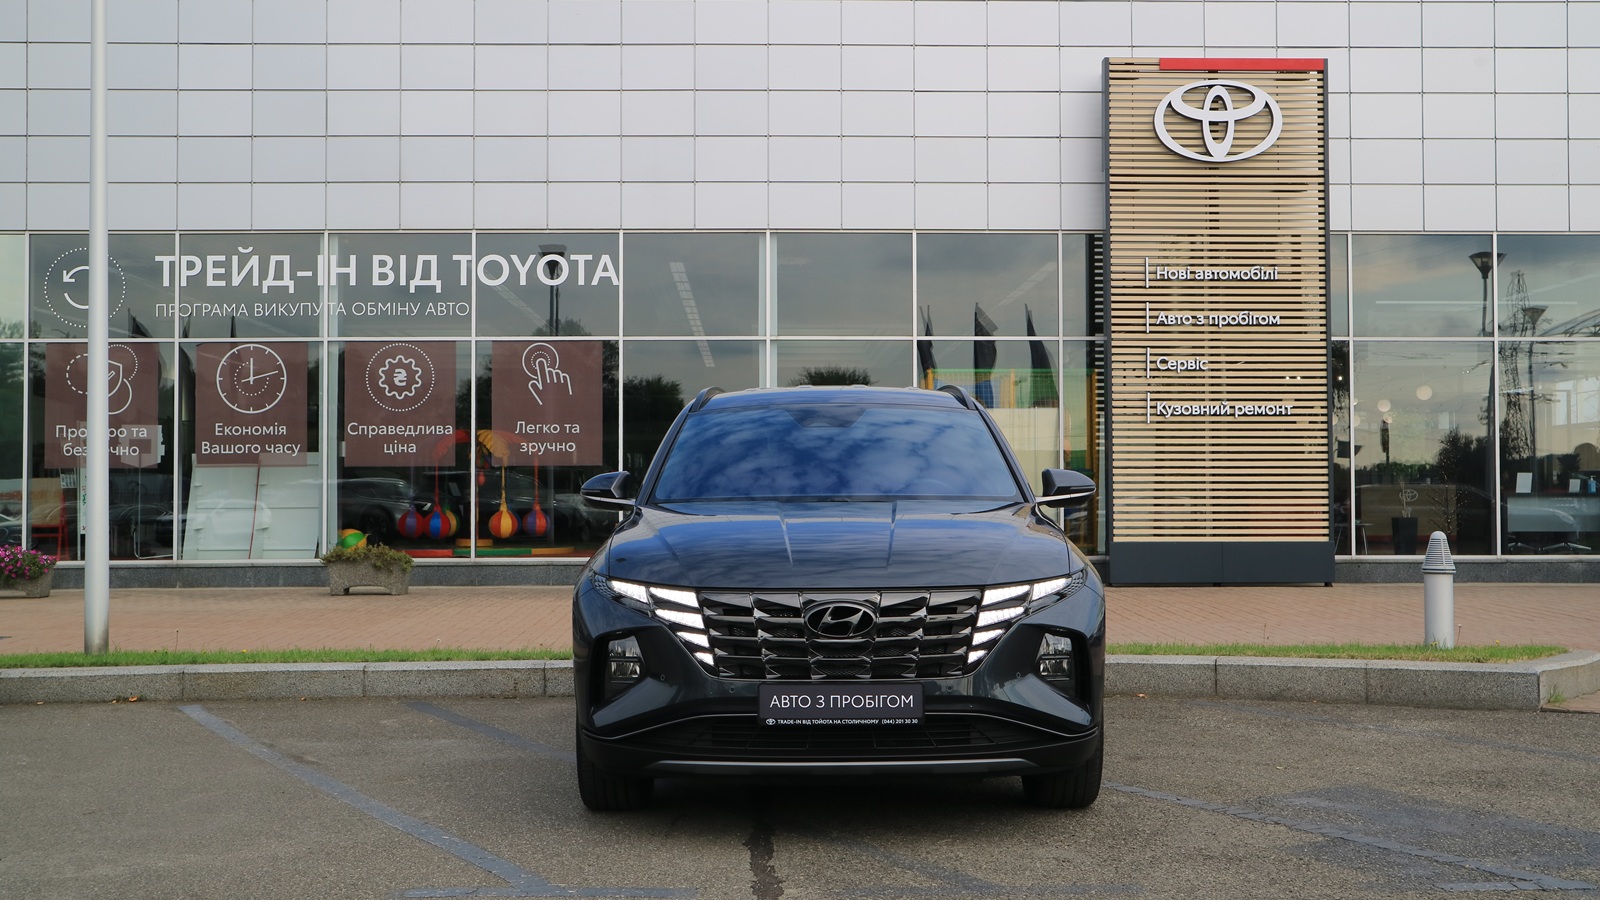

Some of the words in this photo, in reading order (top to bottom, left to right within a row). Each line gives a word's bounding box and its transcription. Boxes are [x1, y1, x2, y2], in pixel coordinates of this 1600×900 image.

[155, 246, 357, 293] ТРЕЙД-ІН
[372, 254, 442, 293] ВІД
[452, 254, 619, 286] TOYOTA
[1156, 266, 1191, 280] Нові
[1195, 266, 1278, 280] автомобілі
[155, 303, 249, 317] ПРОГРАМА
[254, 303, 323, 317] ВИКУПУ
[327, 302, 347, 316] ТА
[352, 302, 421, 316] ОБМІНУ
[425, 302, 470, 316] АВТО
[1156, 311, 1192, 325] Авто
[1196, 314, 1205, 325] з
[1209, 311, 1280, 328] пробігом
[1156, 357, 1209, 373] Сервіс
[1156, 401, 1230, 418] Кузовний
[1234, 404, 1294, 419] ремонт
[55, 425, 127, 440] Проро
[131, 427, 148, 437] та
[215, 422, 287, 436] Економія
[347, 422, 453, 436] Справедлива
[515, 421, 560, 434] Легко
[564, 423, 580, 434] та
[63, 443, 140, 456] безчно
[201, 441, 261, 454] Вашого
[265, 443, 301, 457] часу
[383, 440, 416, 454] ціна
[519, 442, 576, 455] зручно
[769, 695, 811, 708] АВТО
[830, 695, 914, 708] ПРОБІГОМ
